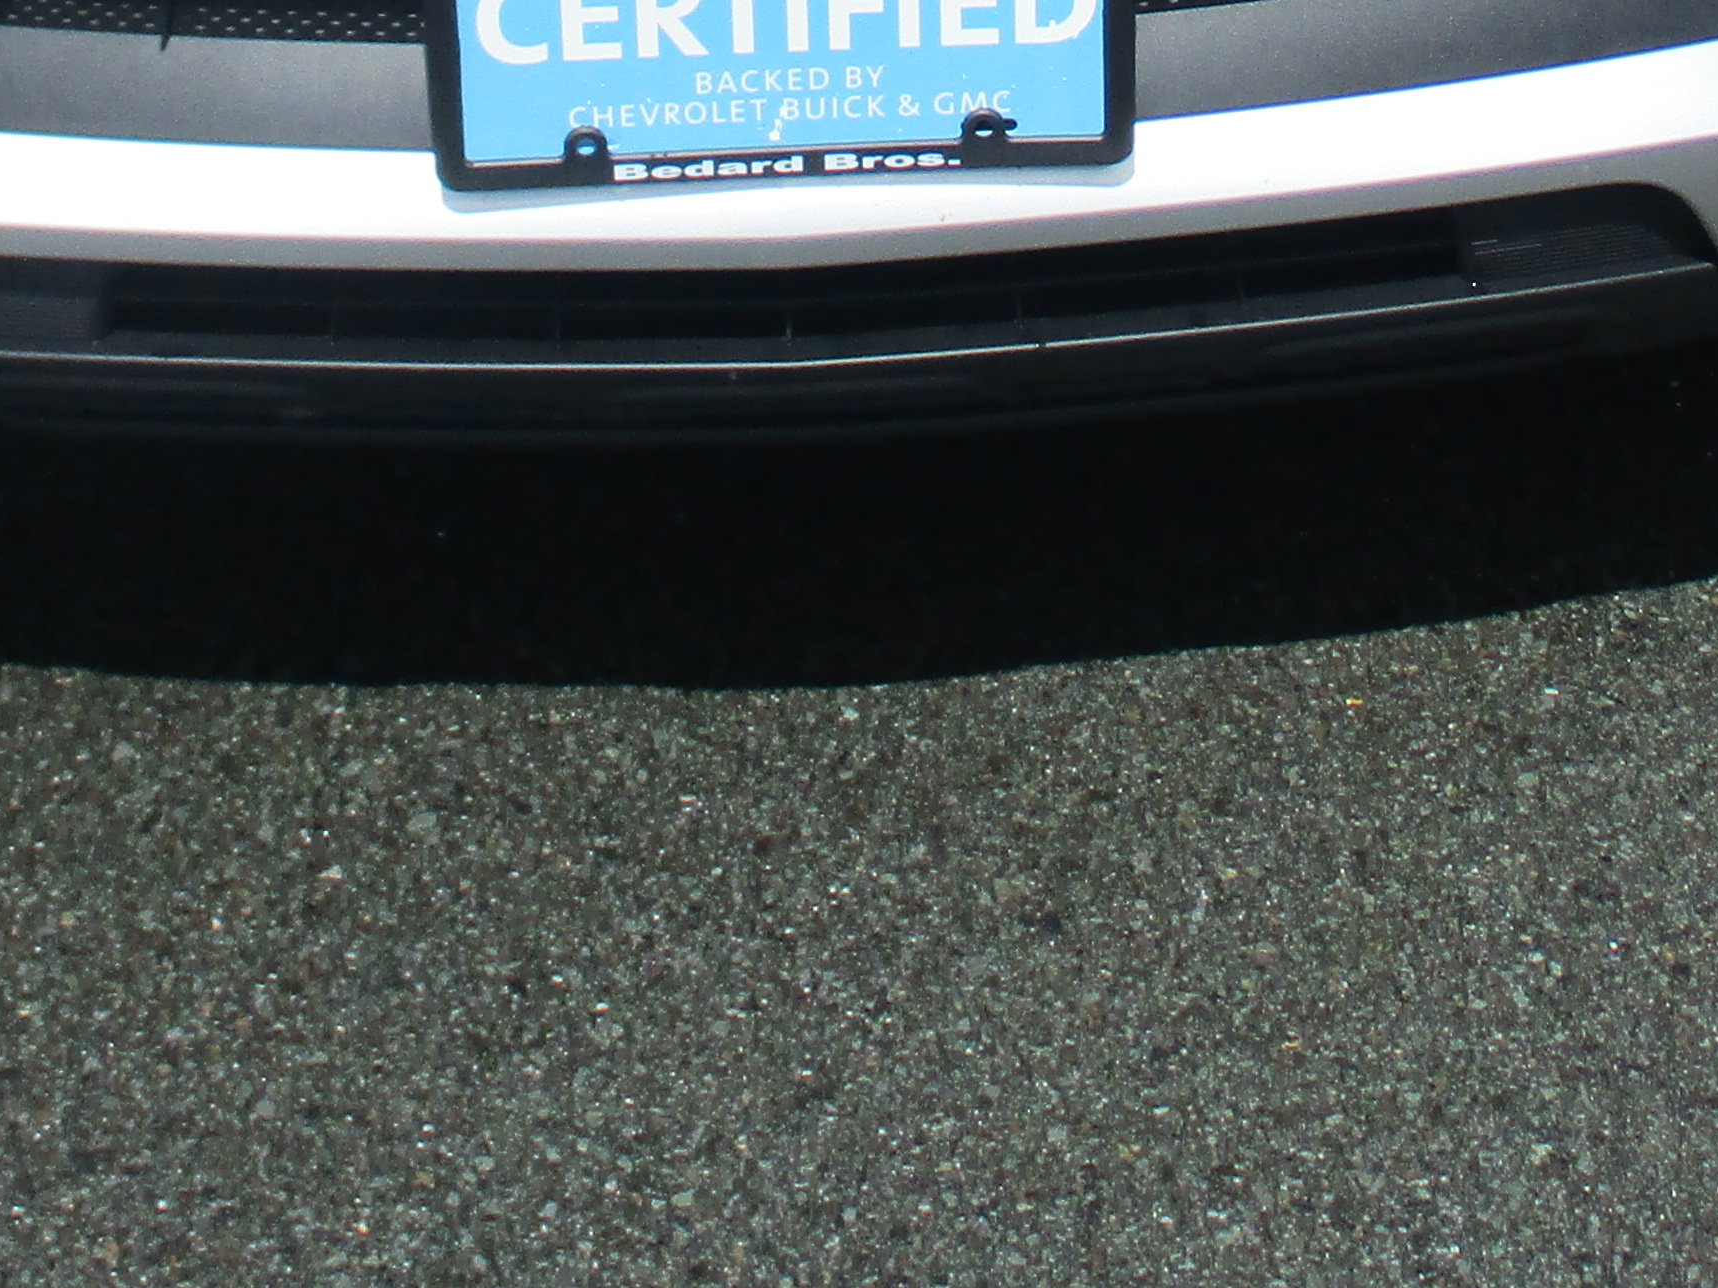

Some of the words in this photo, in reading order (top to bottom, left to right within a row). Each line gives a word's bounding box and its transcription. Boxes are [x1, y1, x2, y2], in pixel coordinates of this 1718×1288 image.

[694, 66, 831, 95] BACKED
[845, 64, 886, 89] BY
[568, 98, 767, 128] CHEVROLET
[781, 94, 885, 121] BUICK
[897, 93, 921, 117] &
[933, 89, 1012, 117] GMC
[613, 154, 804, 182] Bedard
[823, 150, 962, 174] Bros.
